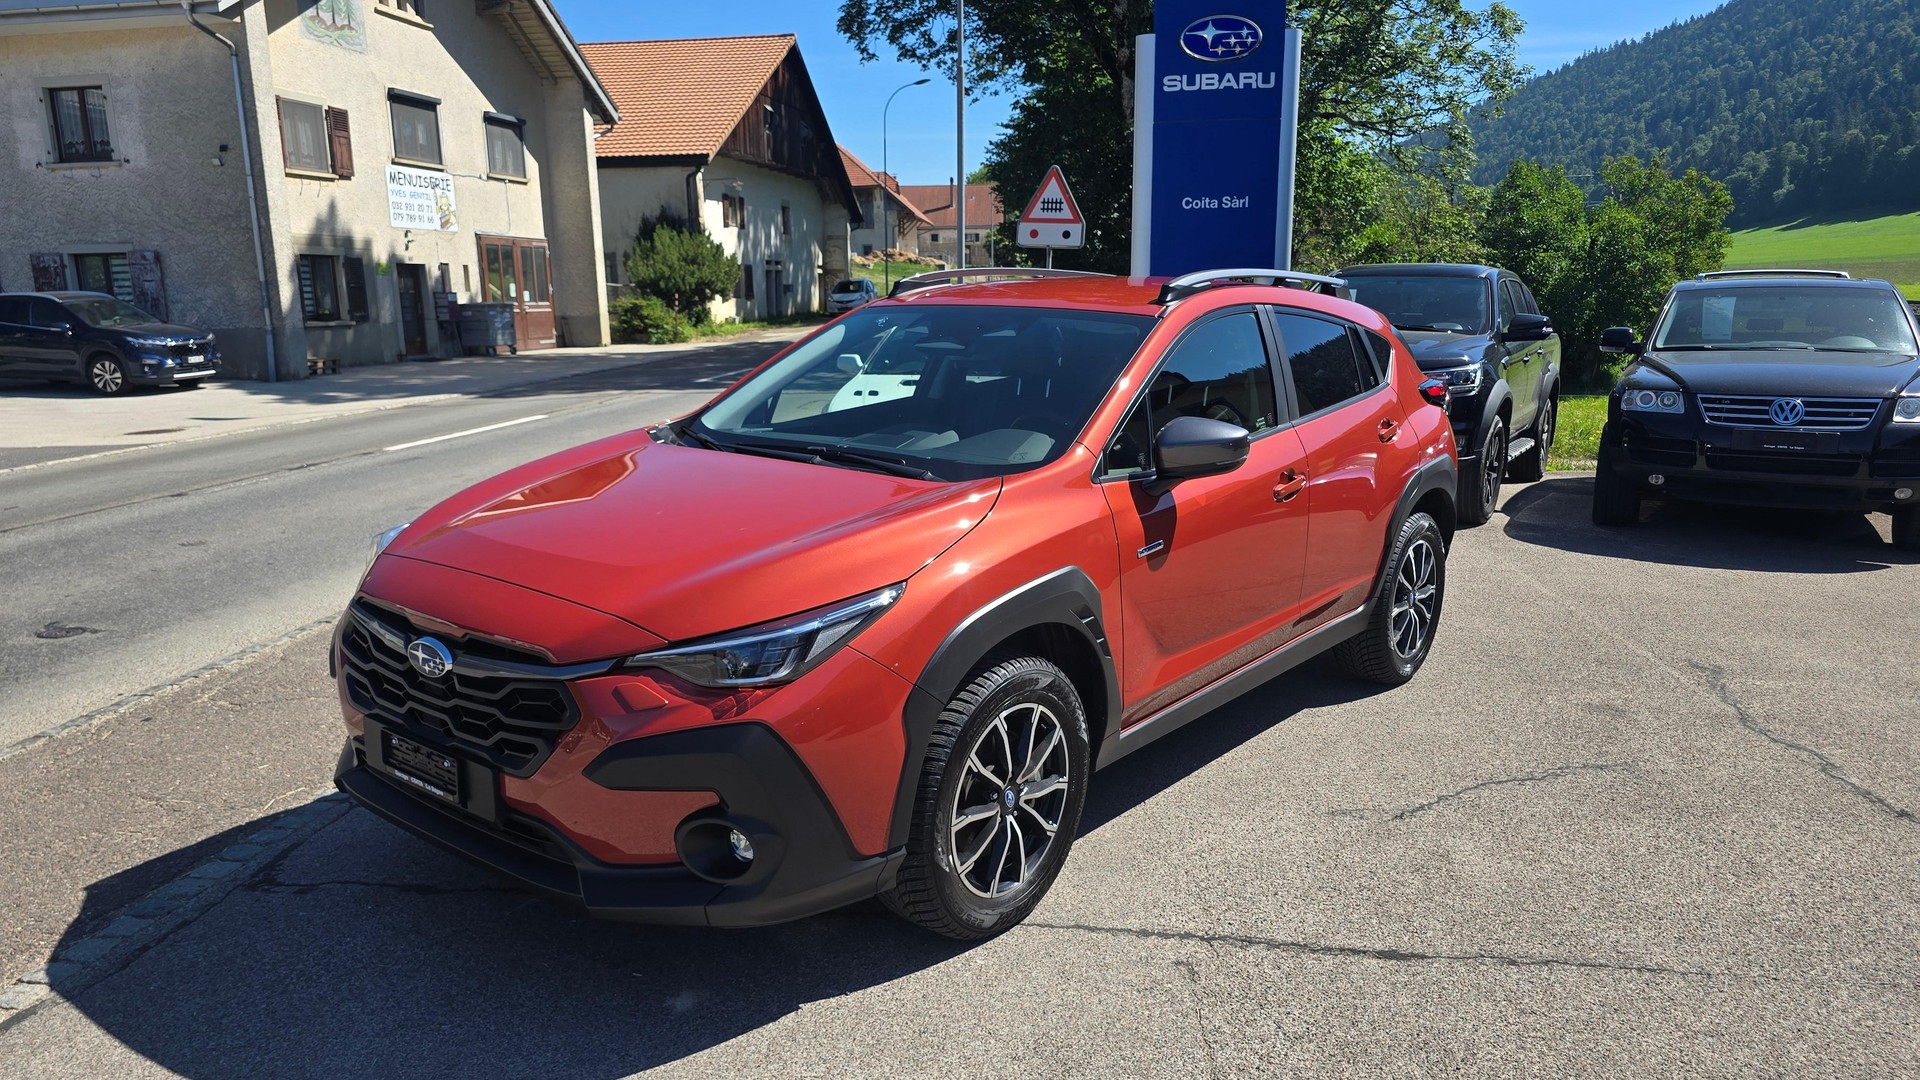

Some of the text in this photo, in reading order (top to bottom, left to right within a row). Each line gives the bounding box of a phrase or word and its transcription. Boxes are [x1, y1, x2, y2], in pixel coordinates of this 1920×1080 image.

[1163, 72, 1275, 92] SUBARU
[389, 171, 451, 192] MENUISERIE
[391, 189, 432, 201] YVES GENTIL
[391, 201, 433, 213] 032 931 20 71
[1181, 195, 1249, 209] Coita Sàrl
[393, 212, 404, 221] 079
[405, 213, 417, 223] 789
[418, 214, 425, 223] 91
